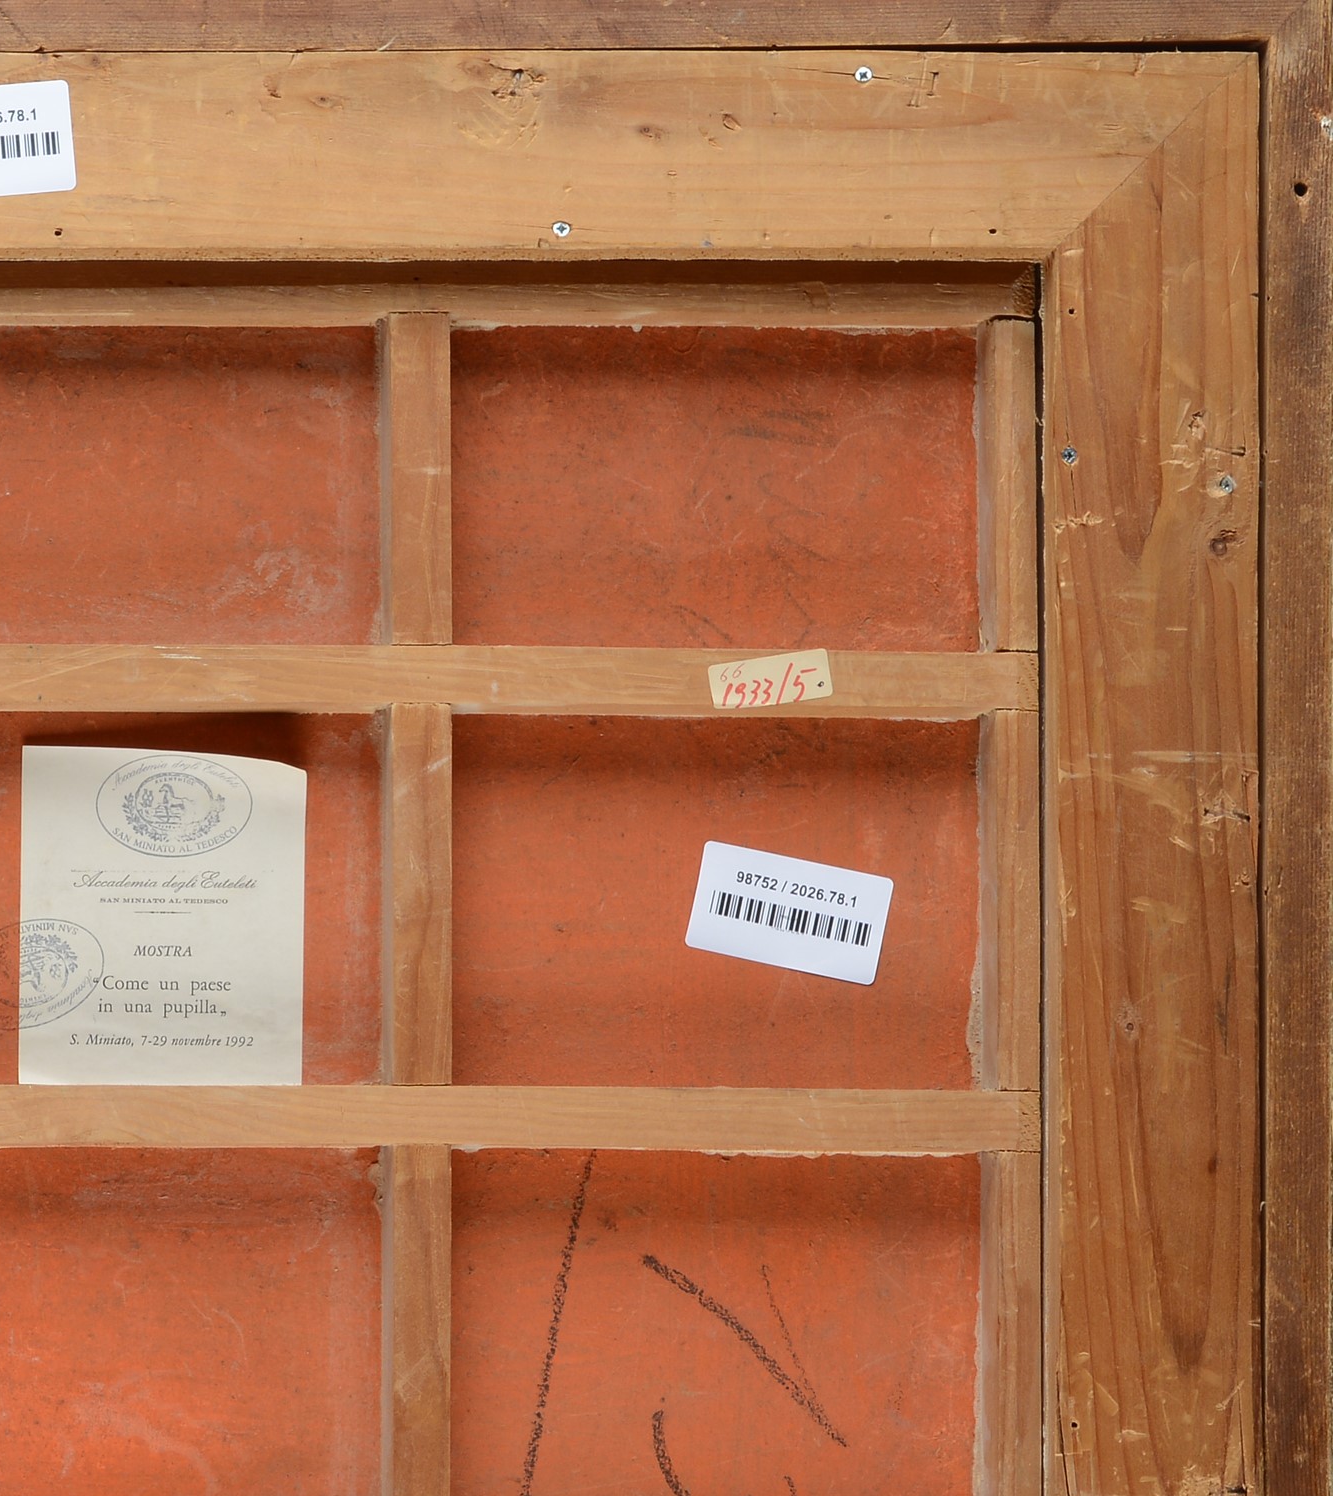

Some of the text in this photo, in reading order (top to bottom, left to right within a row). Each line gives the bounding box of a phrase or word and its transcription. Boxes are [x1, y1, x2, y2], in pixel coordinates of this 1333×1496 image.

[112, 825, 238, 854] SAN MINIATO AL TEDESCO
[73, 870, 258, 894] Accademia degli Euteleti
[736, 871, 858, 908] 98752 / 2026.78.1
[57, 923, 79, 936] SAN
[133, 945, 193, 957] MOSTRA
[159, 979, 180, 991] un
[190, 979, 232, 996] paese
[98, 998, 113, 1013] in
[124, 1002, 153, 1013] una
[69, 1034, 254, 1047] S. Miniato, 7-29 novembre 1992
